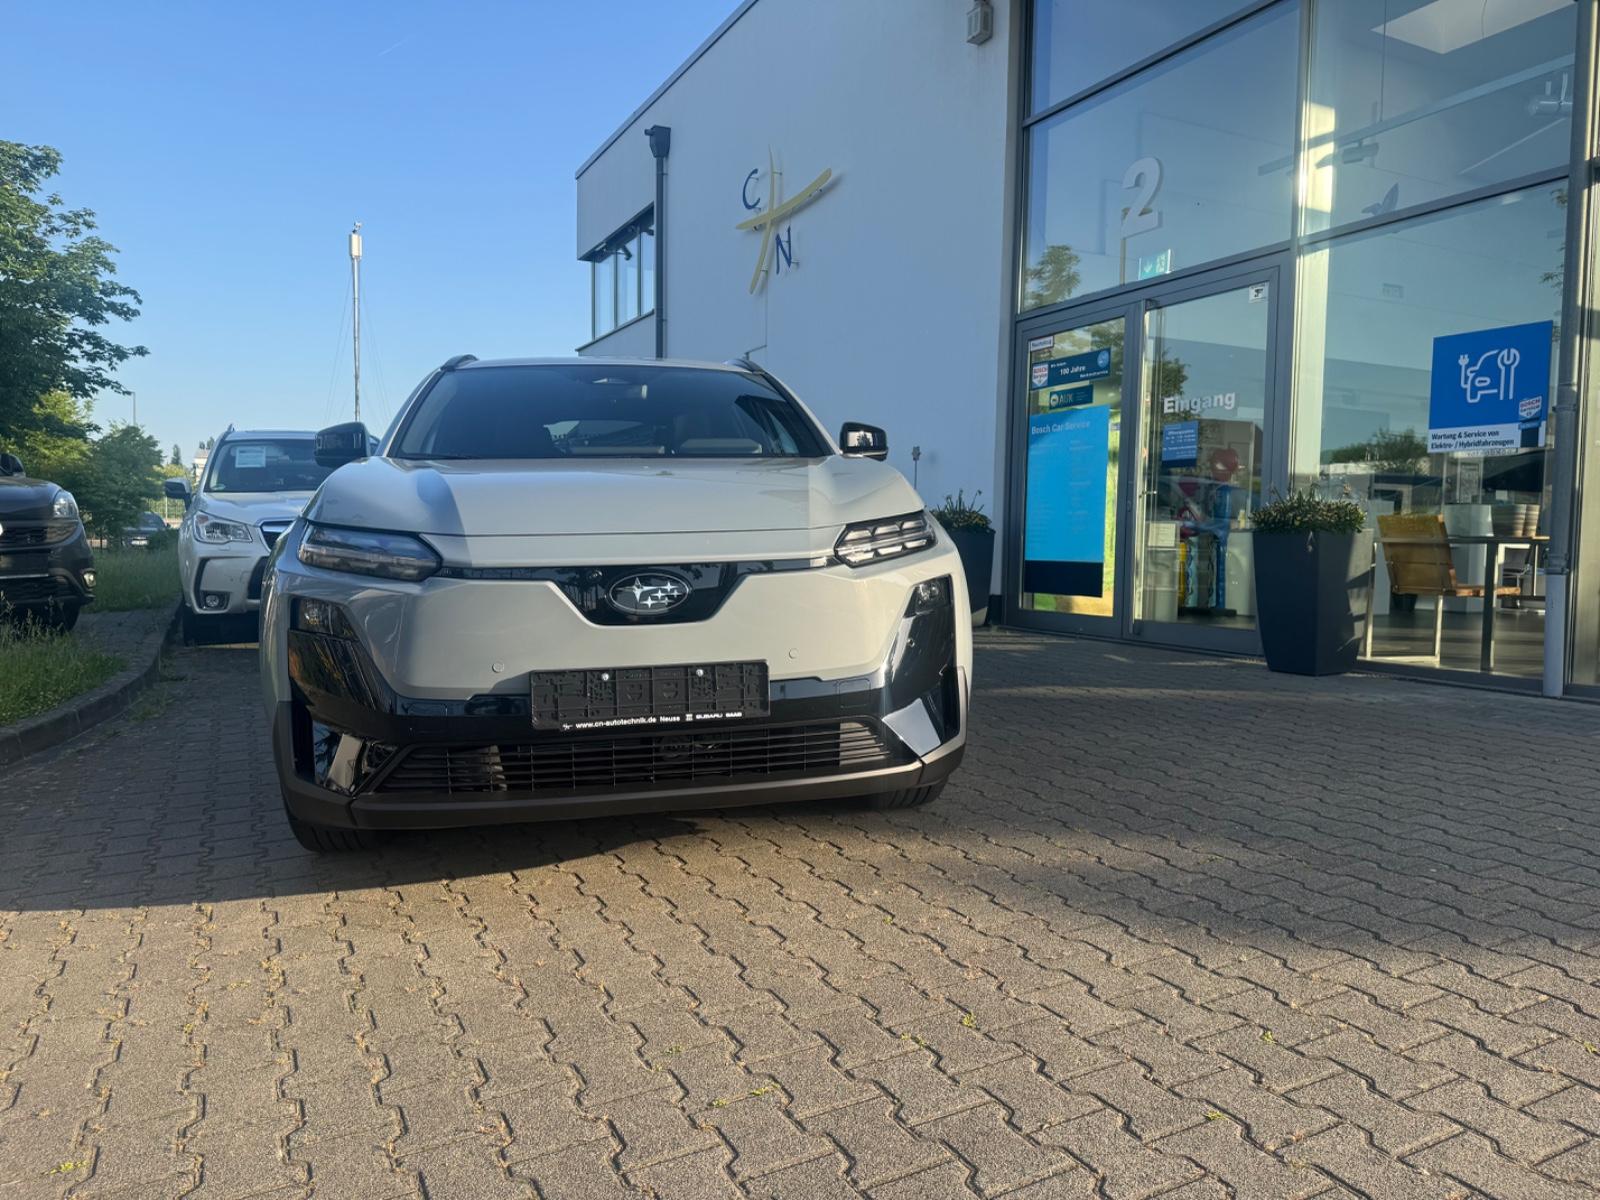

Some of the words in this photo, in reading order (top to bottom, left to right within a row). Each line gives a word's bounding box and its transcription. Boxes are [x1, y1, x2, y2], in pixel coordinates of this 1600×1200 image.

[742, 168, 761, 210] C
[1121, 157, 1163, 239] 2
[775, 225, 792, 275] N
[1163, 391, 1236, 414] Eingang
[1031, 425, 1051, 435] Bosch
[1052, 423, 1063, 433] Car
[1431, 432, 1456, 441] Wartung
[1457, 432, 1462, 440] &
[1464, 430, 1487, 439] Service
[1431, 441, 1454, 449] Elektro-
[1459, 438, 1514, 448] Hybridfahrzeugen
[575, 716, 657, 729] www.cn-autotechnik.de
